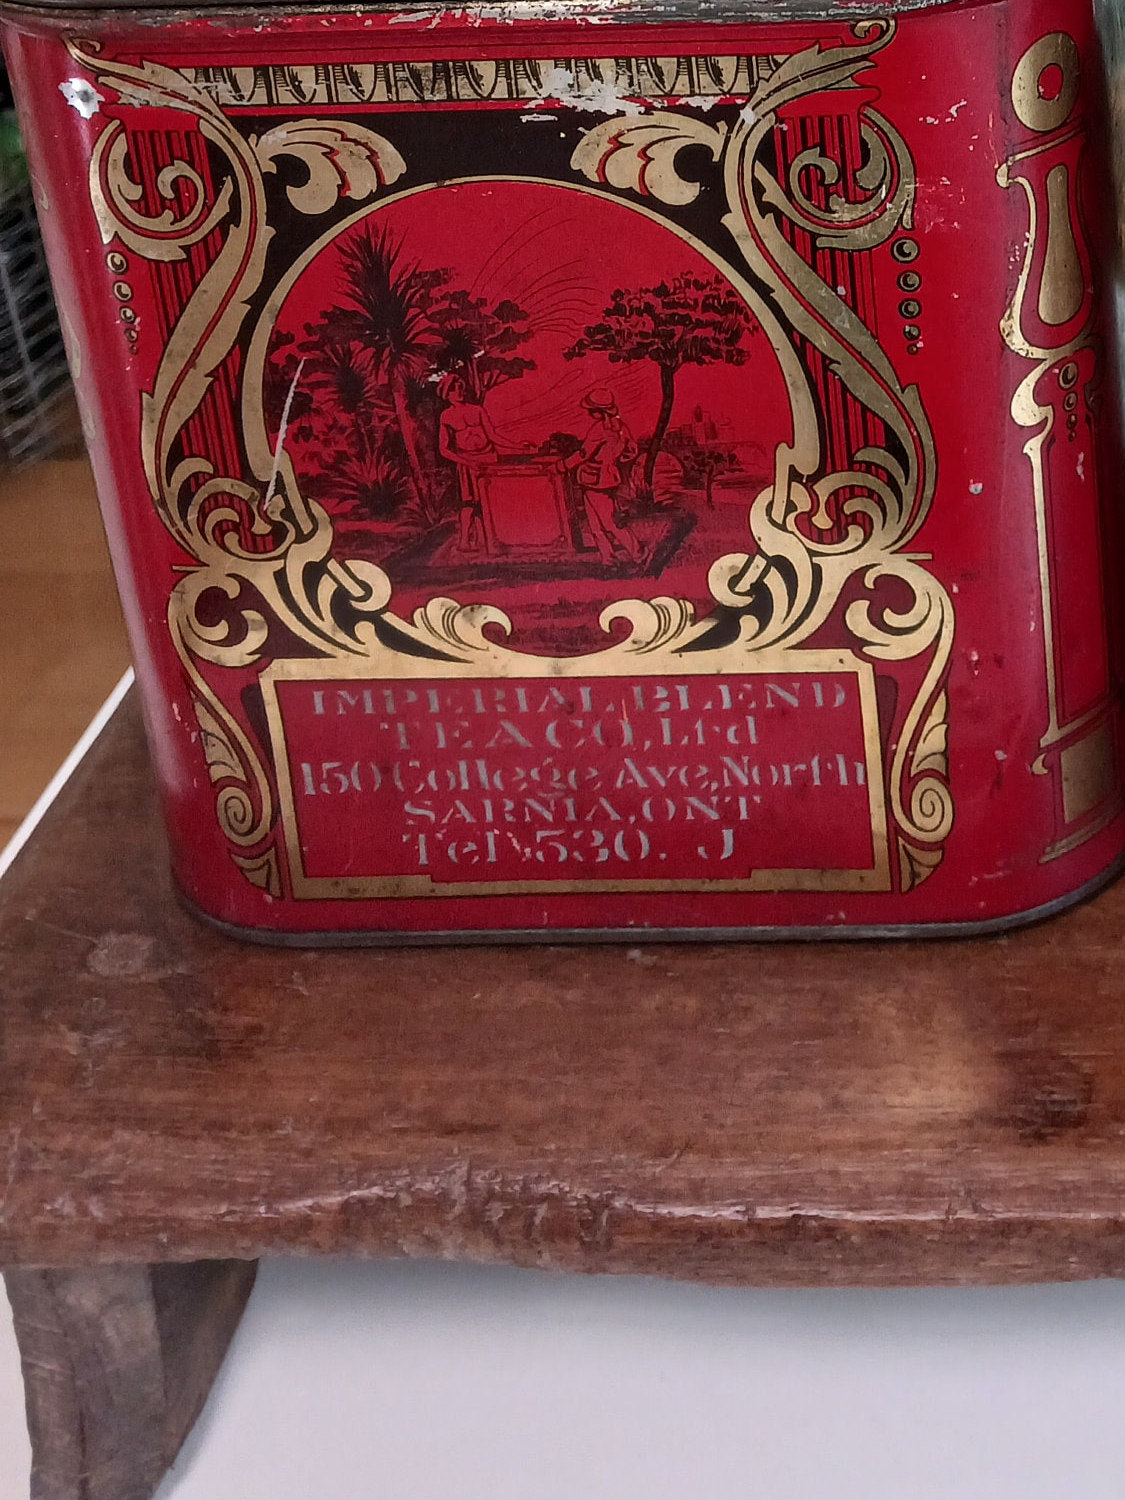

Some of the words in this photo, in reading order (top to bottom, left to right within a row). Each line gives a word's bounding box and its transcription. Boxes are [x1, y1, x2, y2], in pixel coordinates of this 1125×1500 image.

[313, 684, 614, 715] IMPERIAL
[632, 681, 846, 712] BLEND
[301, 761, 381, 796] 150
[393, 757, 602, 798] College
